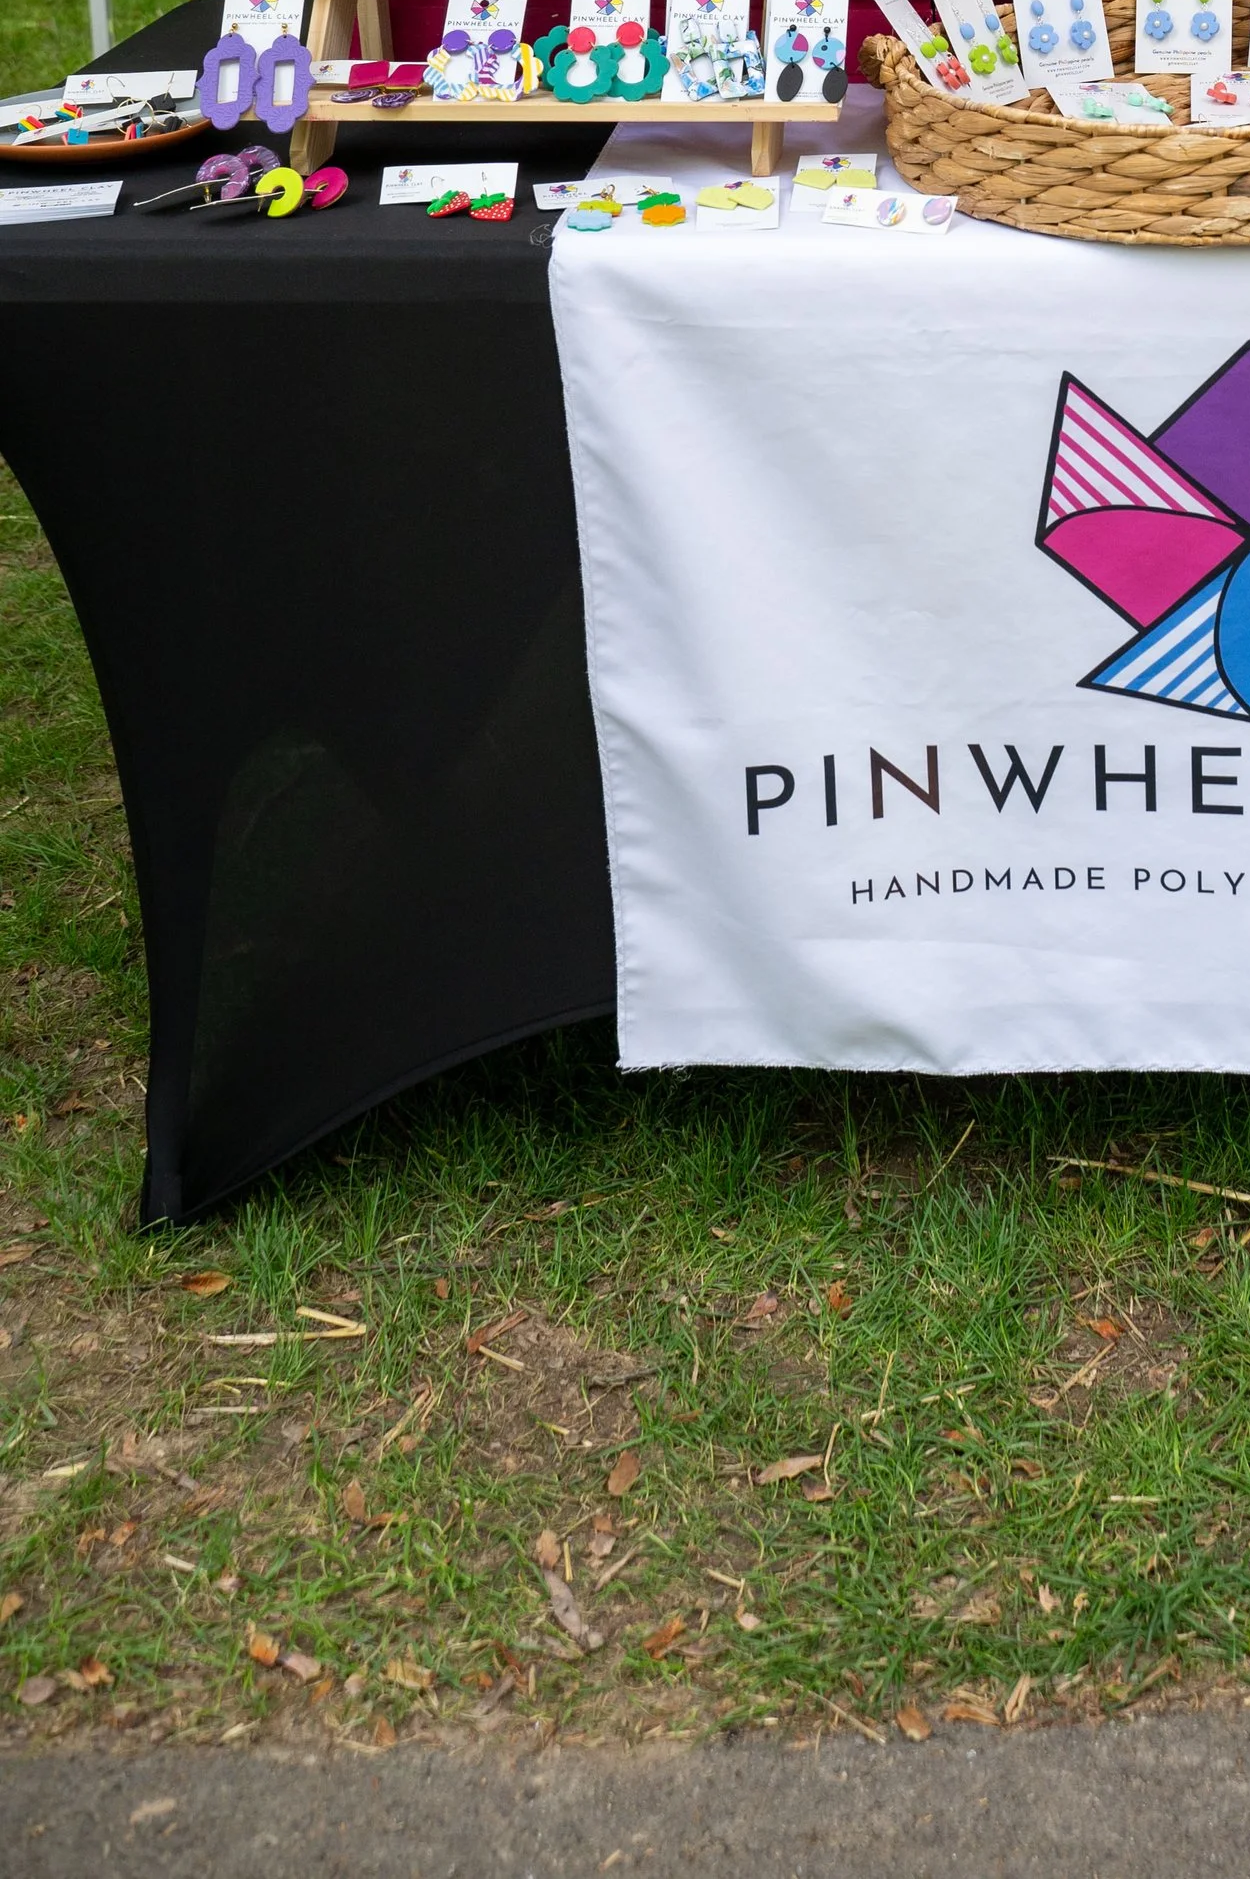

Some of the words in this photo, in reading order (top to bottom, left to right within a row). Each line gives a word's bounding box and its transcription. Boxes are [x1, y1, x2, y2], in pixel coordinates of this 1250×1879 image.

[226, 13, 273, 21] PINWHEEL
[447, 20, 493, 28] PINWHEEL
[851, 866, 1105, 905] HANDMADE
